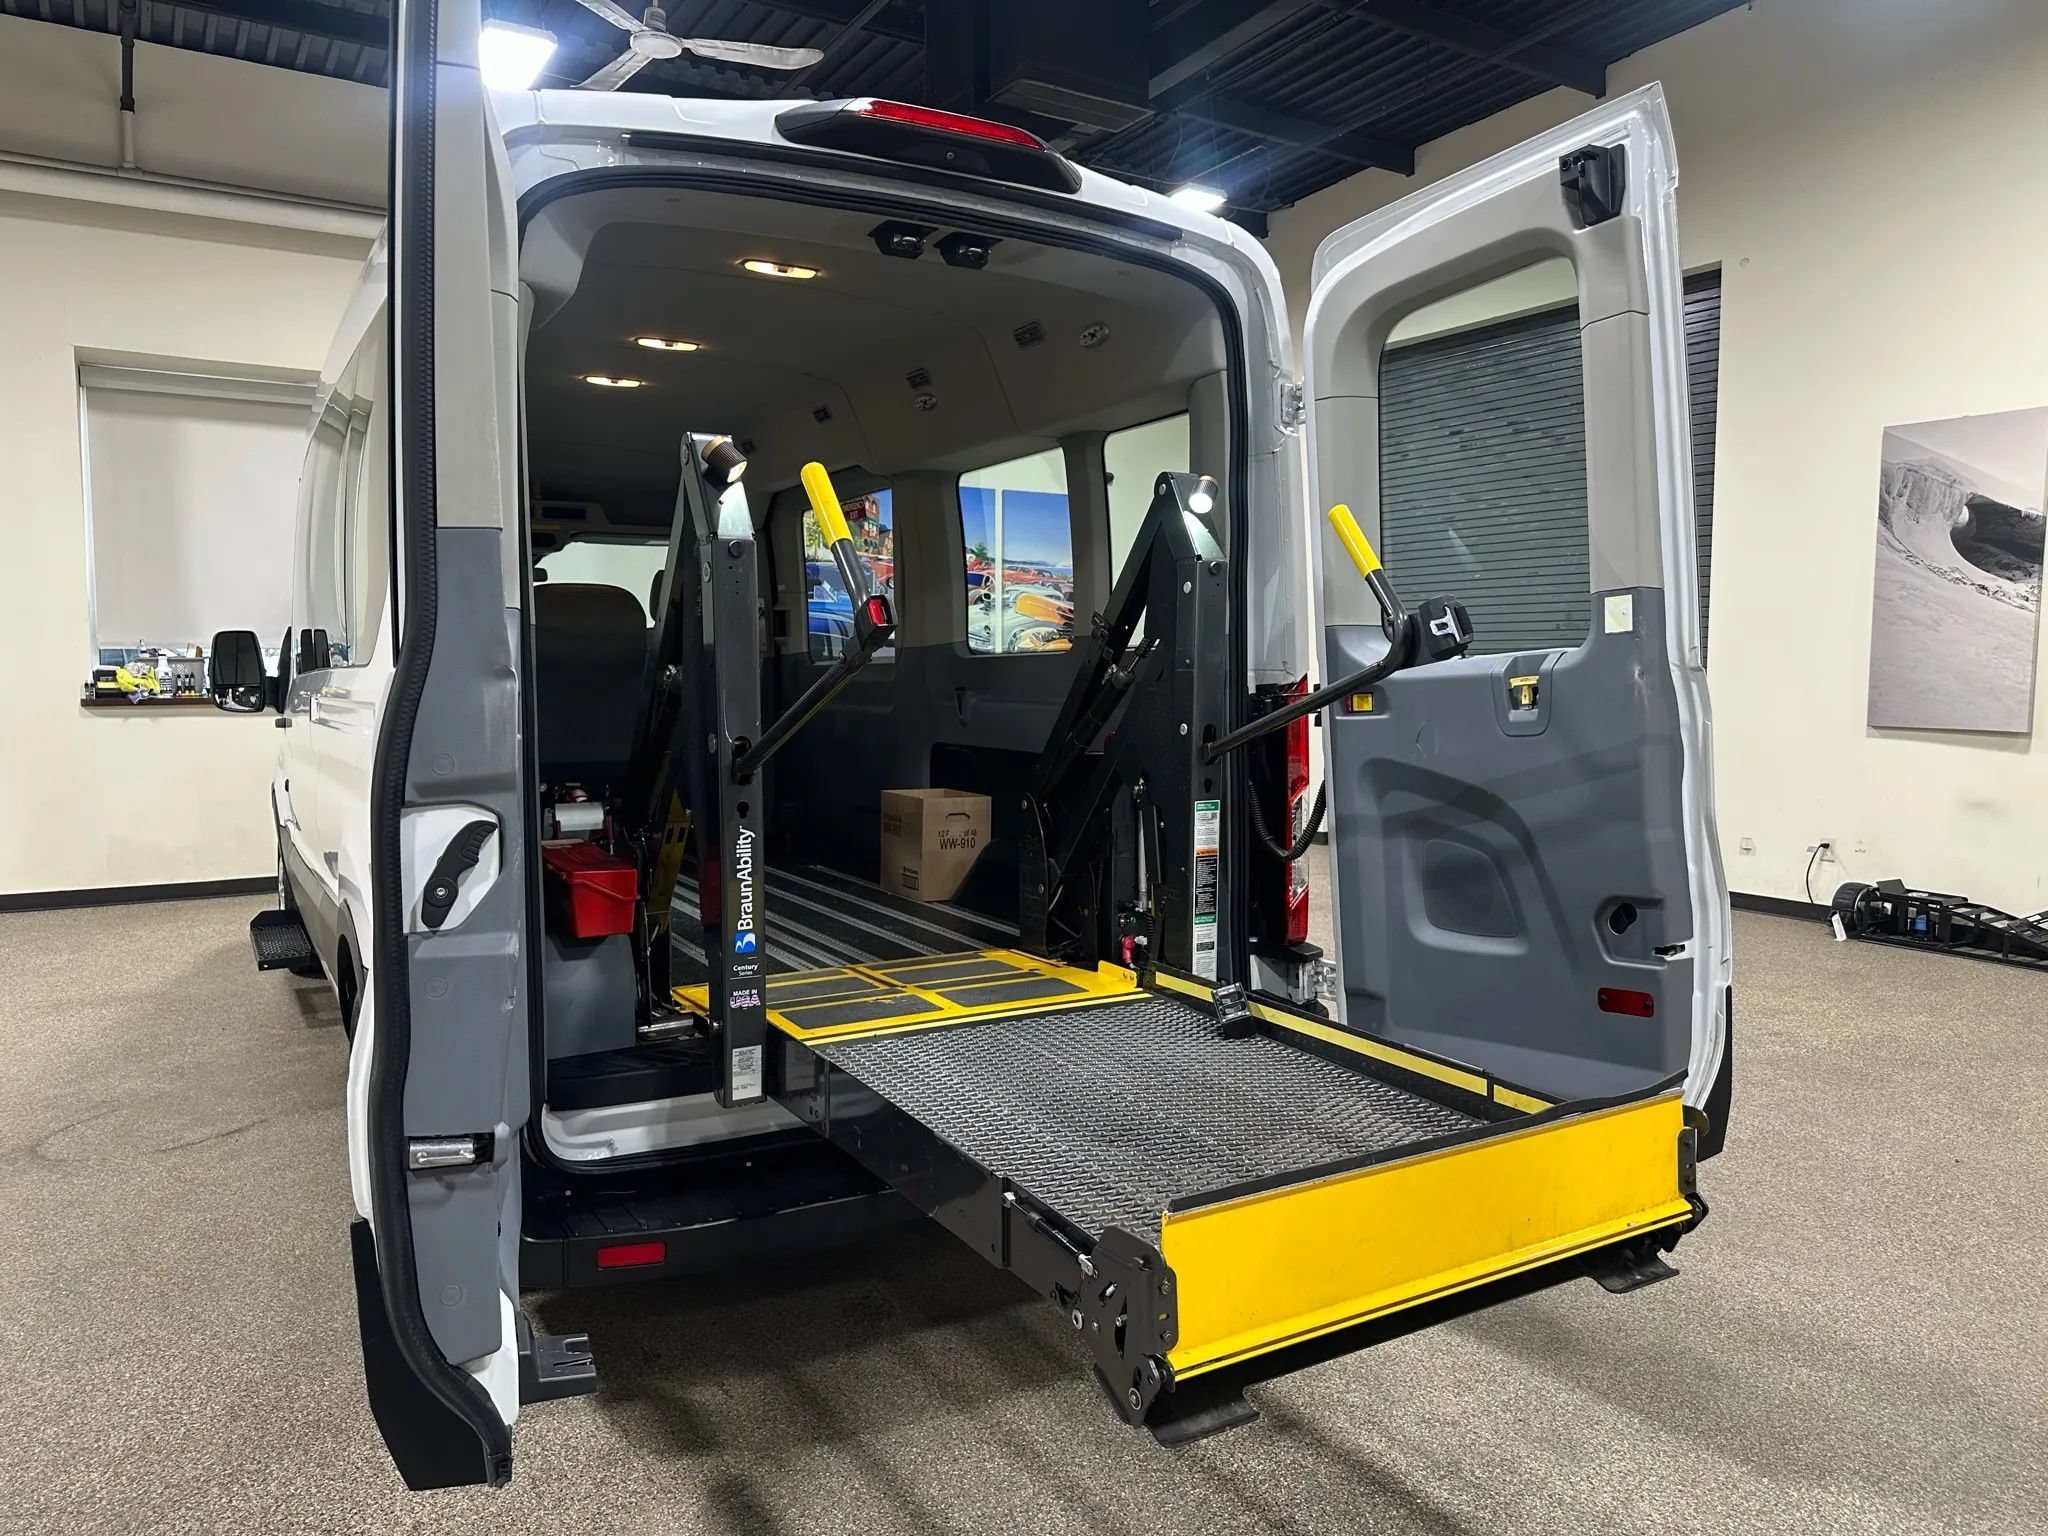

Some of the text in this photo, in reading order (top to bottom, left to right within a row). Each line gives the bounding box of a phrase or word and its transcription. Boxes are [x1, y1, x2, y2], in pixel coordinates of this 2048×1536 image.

[939, 837, 976, 850] WW-910
[736, 826, 756, 931] BraunAbility
[733, 963, 758, 972] Century
[733, 989, 751, 997] MADE
[730, 994, 761, 1009] USA
